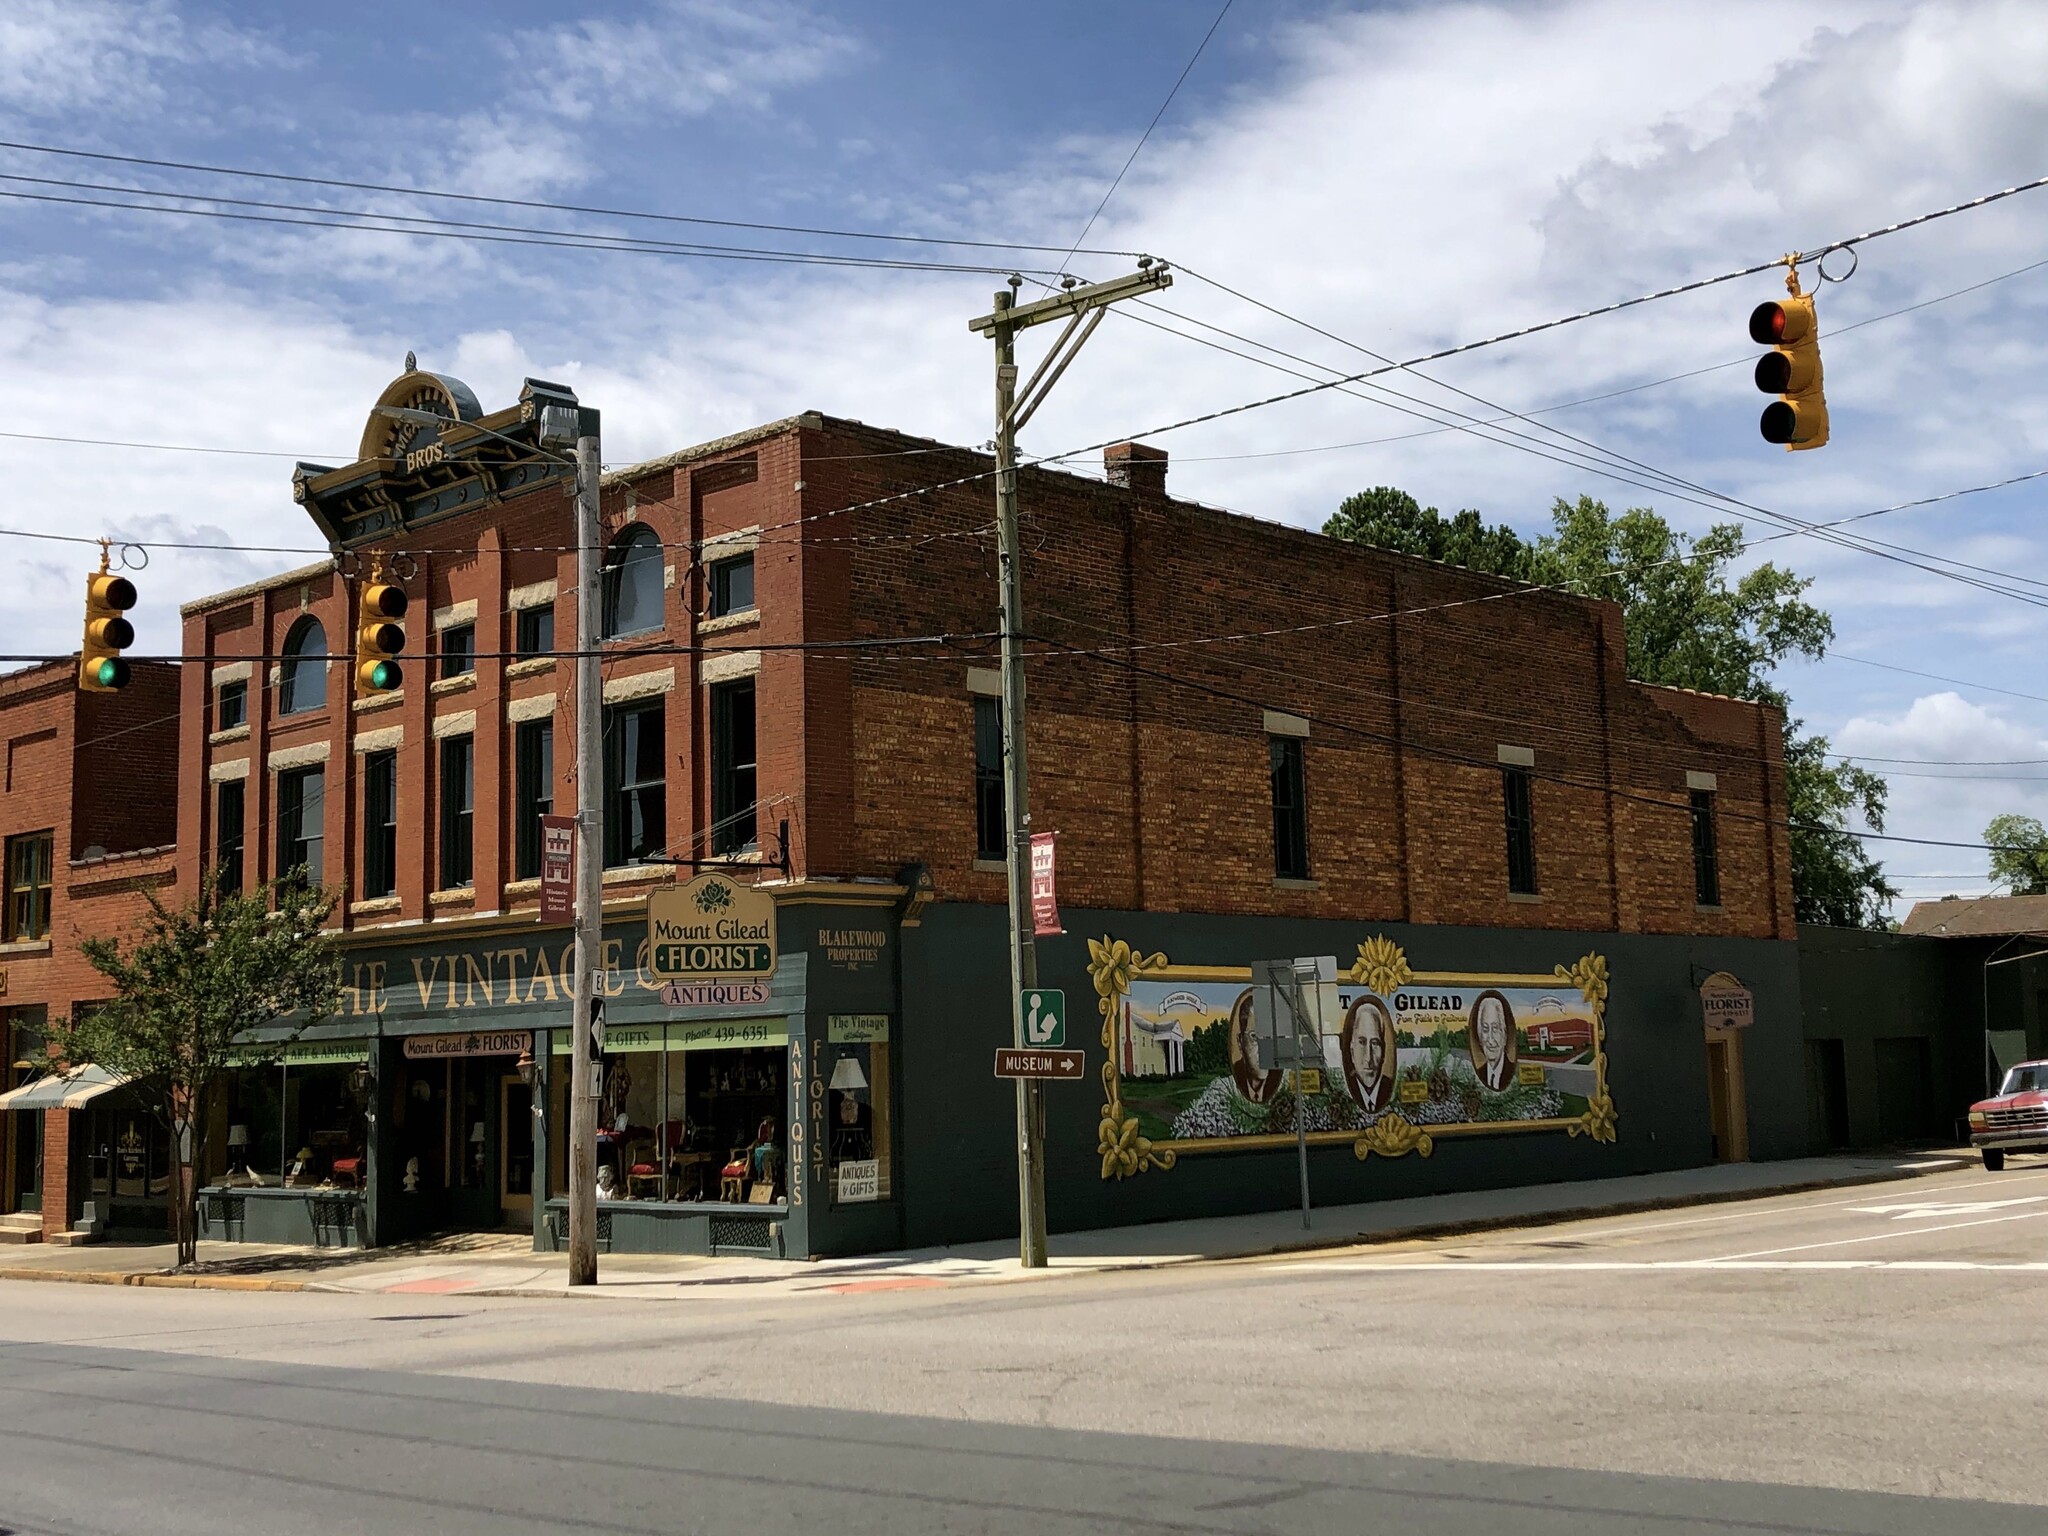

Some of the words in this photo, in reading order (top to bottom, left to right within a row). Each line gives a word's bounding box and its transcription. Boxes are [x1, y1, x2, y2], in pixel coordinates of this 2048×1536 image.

[655, 919, 711, 940] Mount
[716, 918, 770, 940] Gilead
[818, 929, 886, 947] BLAKEWOOD
[668, 946, 759, 970] FLORIST
[827, 948, 878, 961] PROPERTIES
[670, 985, 763, 1004] ANTIQUES
[1394, 993, 1463, 1011] GILEAD
[1704, 998, 1751, 1010] FLORIST
[831, 1016, 849, 1030] The
[851, 1015, 885, 1031] Vintage
[408, 1040, 433, 1054] Mount
[436, 1037, 462, 1053] Gilead
[483, 1033, 527, 1051] FLORIST
[616, 1030, 650, 1047] GIFTS
[684, 1026, 712, 1044] Phone
[714, 1025, 768, 1042] 439-6351
[290, 1047, 309, 1060] ART
[311, 1046, 320, 1059] &
[321, 1043, 368, 1060] ANTIQUES
[1006, 1056, 1053, 1072] MUSEUM
[810, 1039, 825, 1183] FLORIST
[791, 1040, 804, 1206] ANTIQUES
[841, 1165, 876, 1181] ANTIQUES
[849, 1181, 875, 1196] GIFTS
